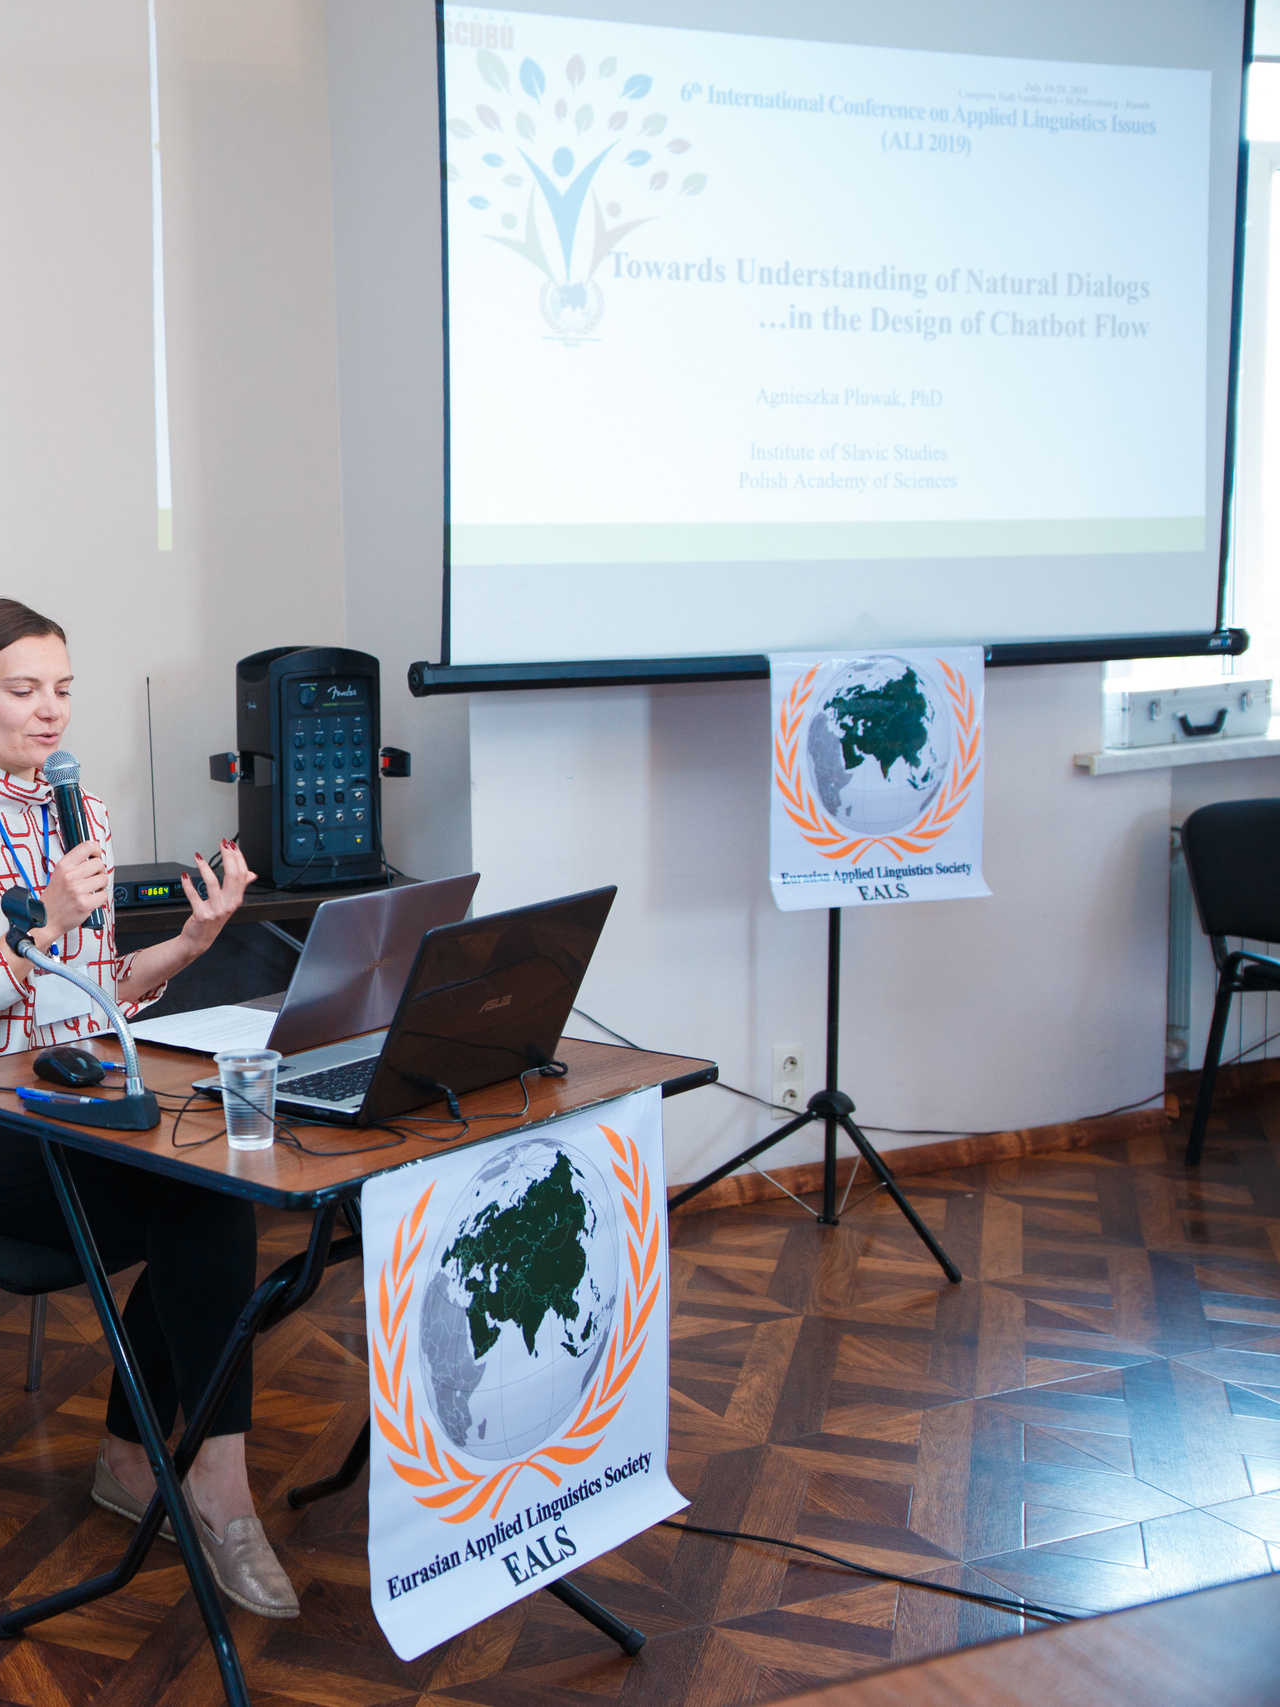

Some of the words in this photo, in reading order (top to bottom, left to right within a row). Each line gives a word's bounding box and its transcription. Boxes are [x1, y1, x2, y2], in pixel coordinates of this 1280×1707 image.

[708, 84, 824, 113] International
[829, 94, 926, 121] Conference
[930, 107, 949, 122] on
[953, 105, 1018, 130] Applied
[1023, 109, 1107, 133] Linguistics
[1111, 114, 1156, 135] Issues
[881, 130, 924, 154] (ALI
[928, 133, 972, 158] 2019)
[608, 251, 726, 283] Towards
[736, 257, 928, 299] Understanding
[935, 268, 961, 293] of
[966, 268, 1058, 296] Natural
[1066, 272, 1150, 305] Dialogs
[823, 305, 862, 332] the
[870, 306, 952, 341] Design
[961, 311, 985, 336] of
[990, 310, 1087, 338] Chatbot
[1094, 313, 1150, 339] Flow
[756, 387, 839, 409] Agnieszka
[844, 388, 906, 408] Pluwak,
[910, 389, 943, 407] PhD
[751, 443, 814, 461] Institute
[820, 443, 838, 461] of
[841, 443, 889, 462] Slavic
[894, 444, 948, 462] Studies
[739, 472, 788, 489] Polish
[793, 472, 868, 493] Academy
[873, 472, 890, 489] of
[894, 472, 958, 489] Sciences
[327, 685, 357, 699] Fender
[833, 868, 874, 883] Applied
[878, 865, 933, 880] Linguistics
[936, 862, 971, 876] Society
[857, 883, 909, 901] EALS
[478, 995, 513, 1013] ASUS
[386, 1551, 461, 1601] Eurasian
[464, 1514, 524, 1562] Applied
[525, 1476, 602, 1530] Linguistics
[604, 1452, 652, 1488] Society
[500, 1524, 577, 1586] EALS
